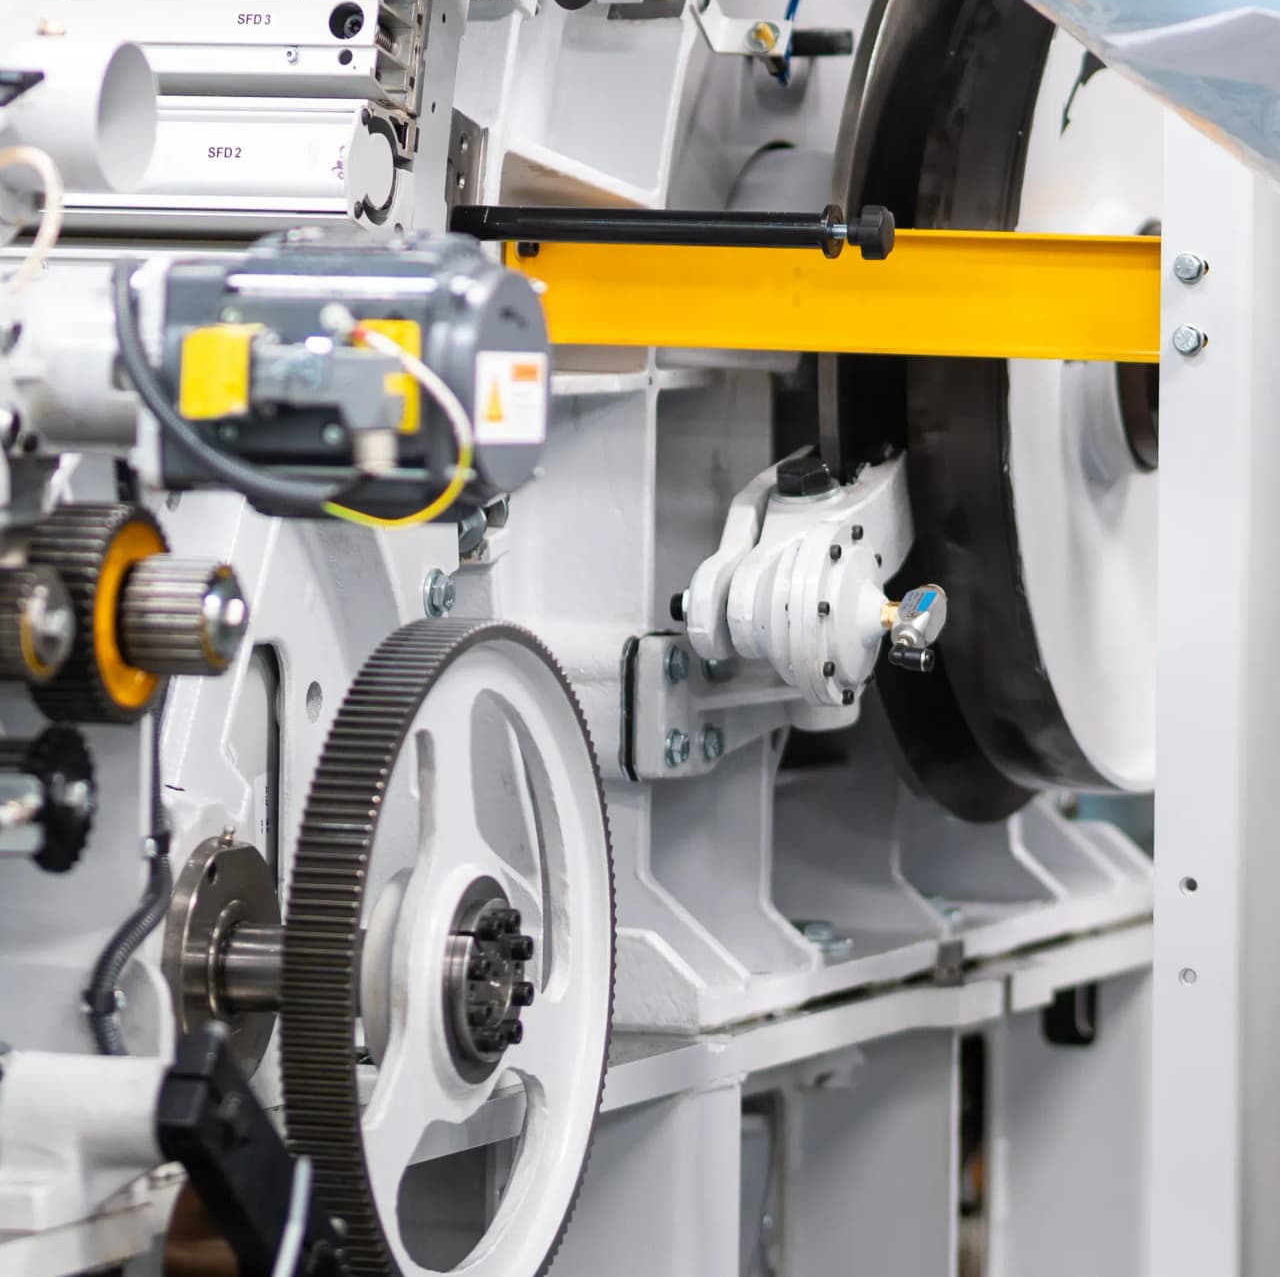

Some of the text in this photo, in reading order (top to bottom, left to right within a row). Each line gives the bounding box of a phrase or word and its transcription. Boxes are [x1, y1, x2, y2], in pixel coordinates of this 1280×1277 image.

[237, 13, 271, 25] SFD 3
[208, 146, 242, 159] SFD 2
